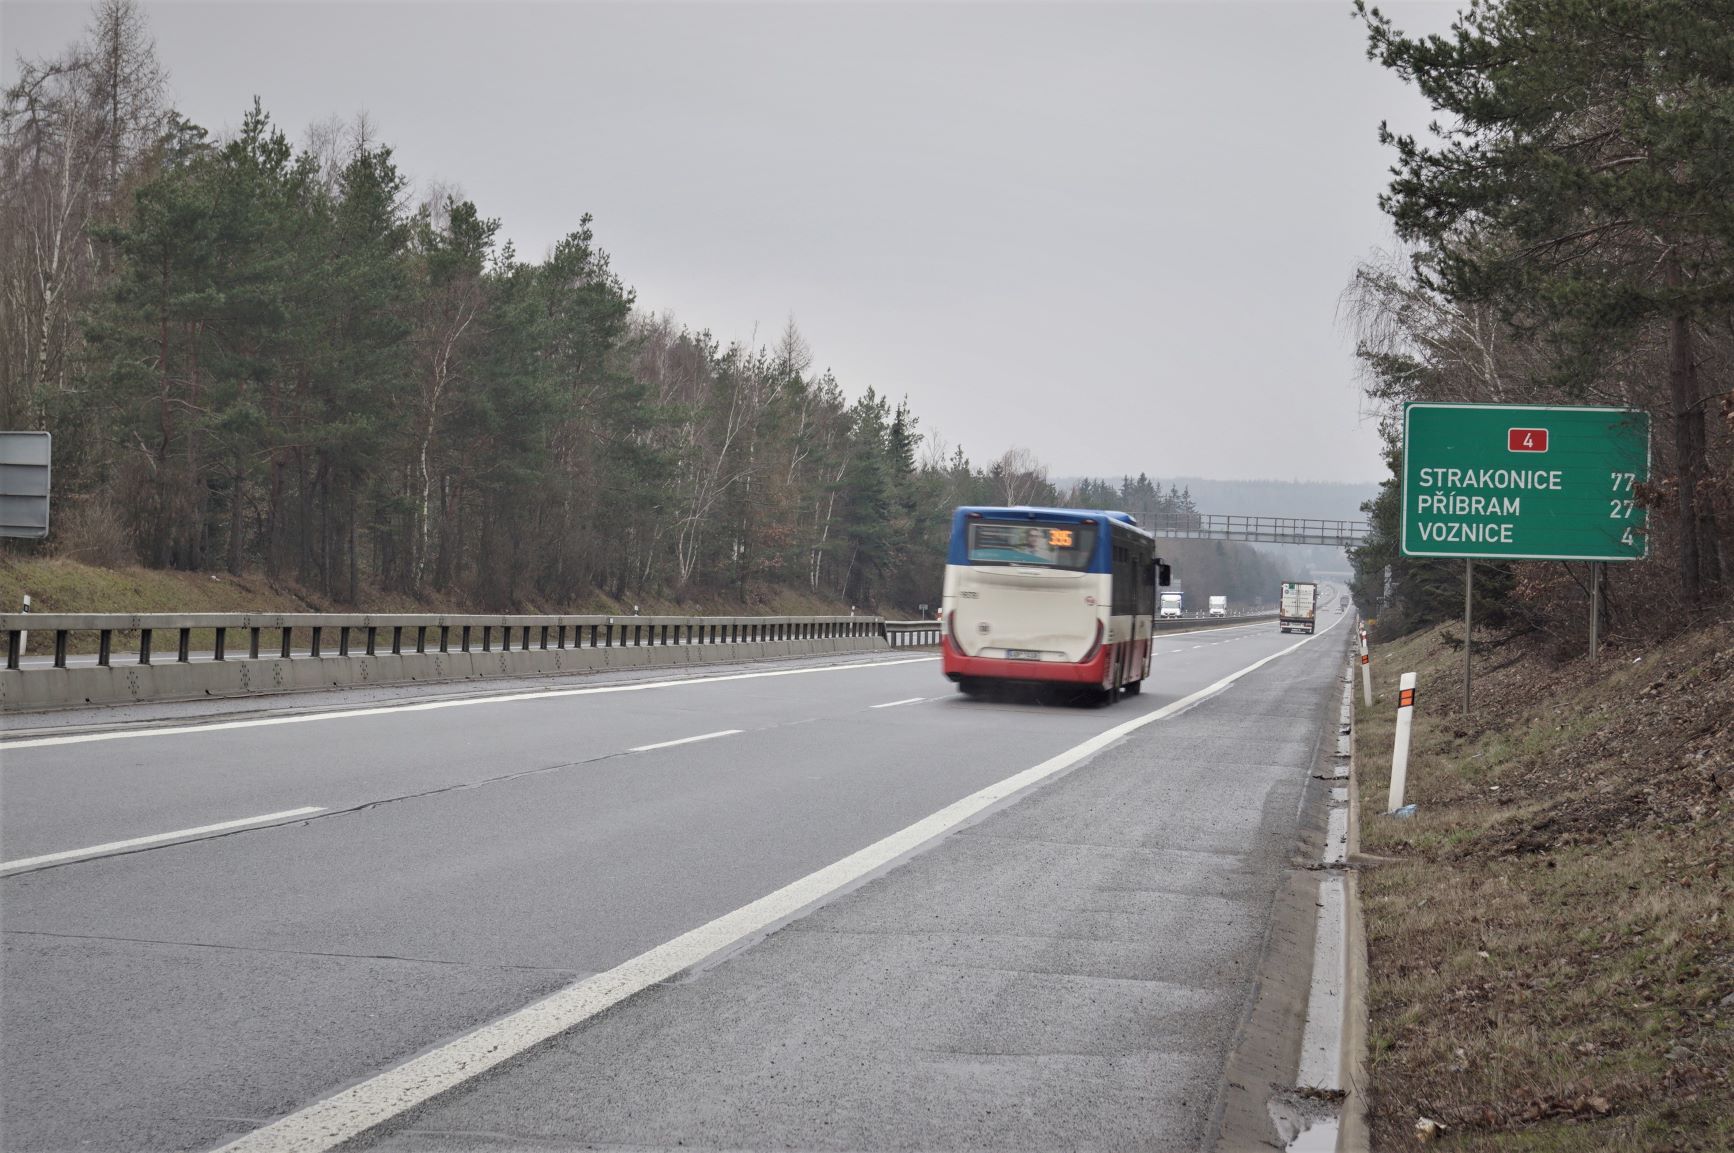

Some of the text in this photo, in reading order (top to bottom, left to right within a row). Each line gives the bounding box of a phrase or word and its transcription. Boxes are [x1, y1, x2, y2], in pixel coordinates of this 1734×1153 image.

[1523, 433, 1534, 448] 4
[1419, 468, 1636, 492] STRAKONICE 77
[1418, 491, 1635, 519] PŘÍBRAM 27
[1418, 522, 1634, 546] VOZNICE 4
